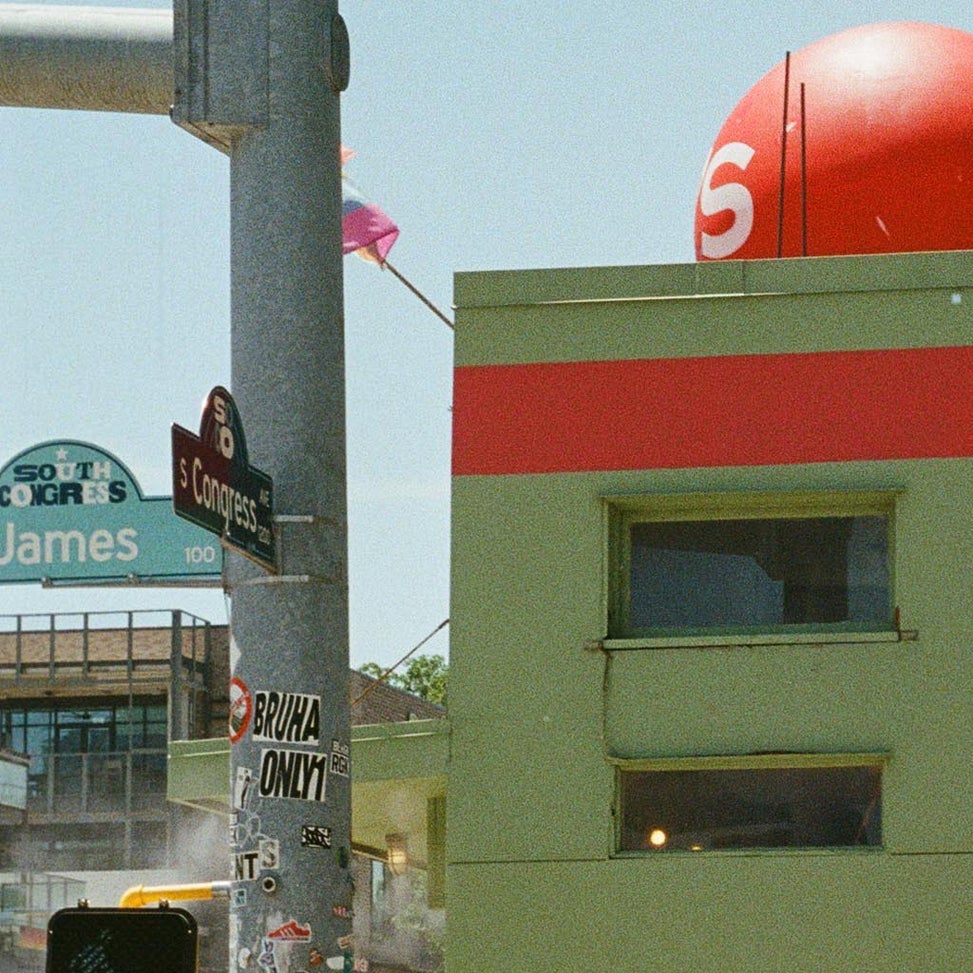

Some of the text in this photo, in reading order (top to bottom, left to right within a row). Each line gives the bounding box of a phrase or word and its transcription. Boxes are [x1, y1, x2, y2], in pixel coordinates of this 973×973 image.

[0, 481, 127, 508] CONGRESS
[13, 461, 112, 483] SOUTH
[179, 457, 188, 489] S
[193, 457, 257, 533] Congress
[0, 521, 216, 566] James 100
[254, 692, 321, 742] BRUHA
[260, 749, 327, 800] ONLY1
